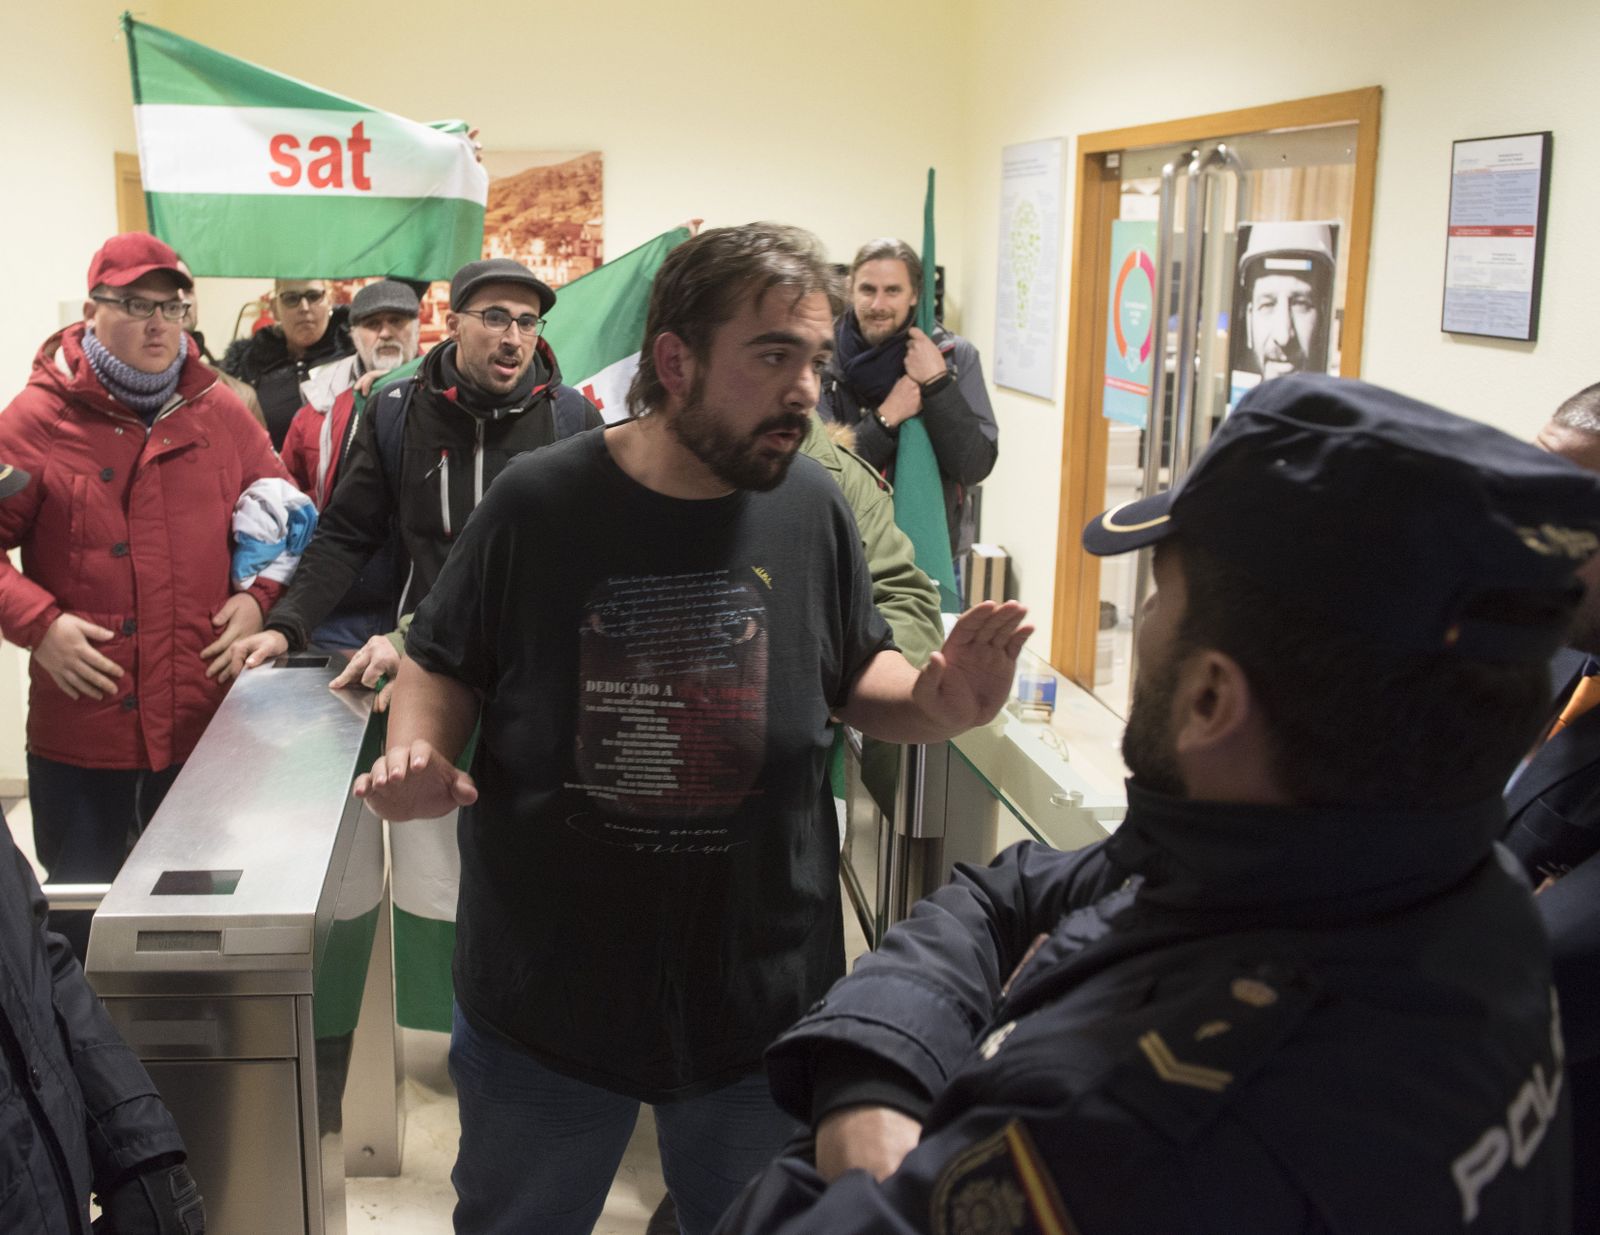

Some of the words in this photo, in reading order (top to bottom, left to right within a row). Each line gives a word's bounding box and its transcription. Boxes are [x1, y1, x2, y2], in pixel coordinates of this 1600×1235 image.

[269, 120, 372, 191] sat
[585, 680, 659, 696] DEDICADO
[662, 684, 674, 697] A
